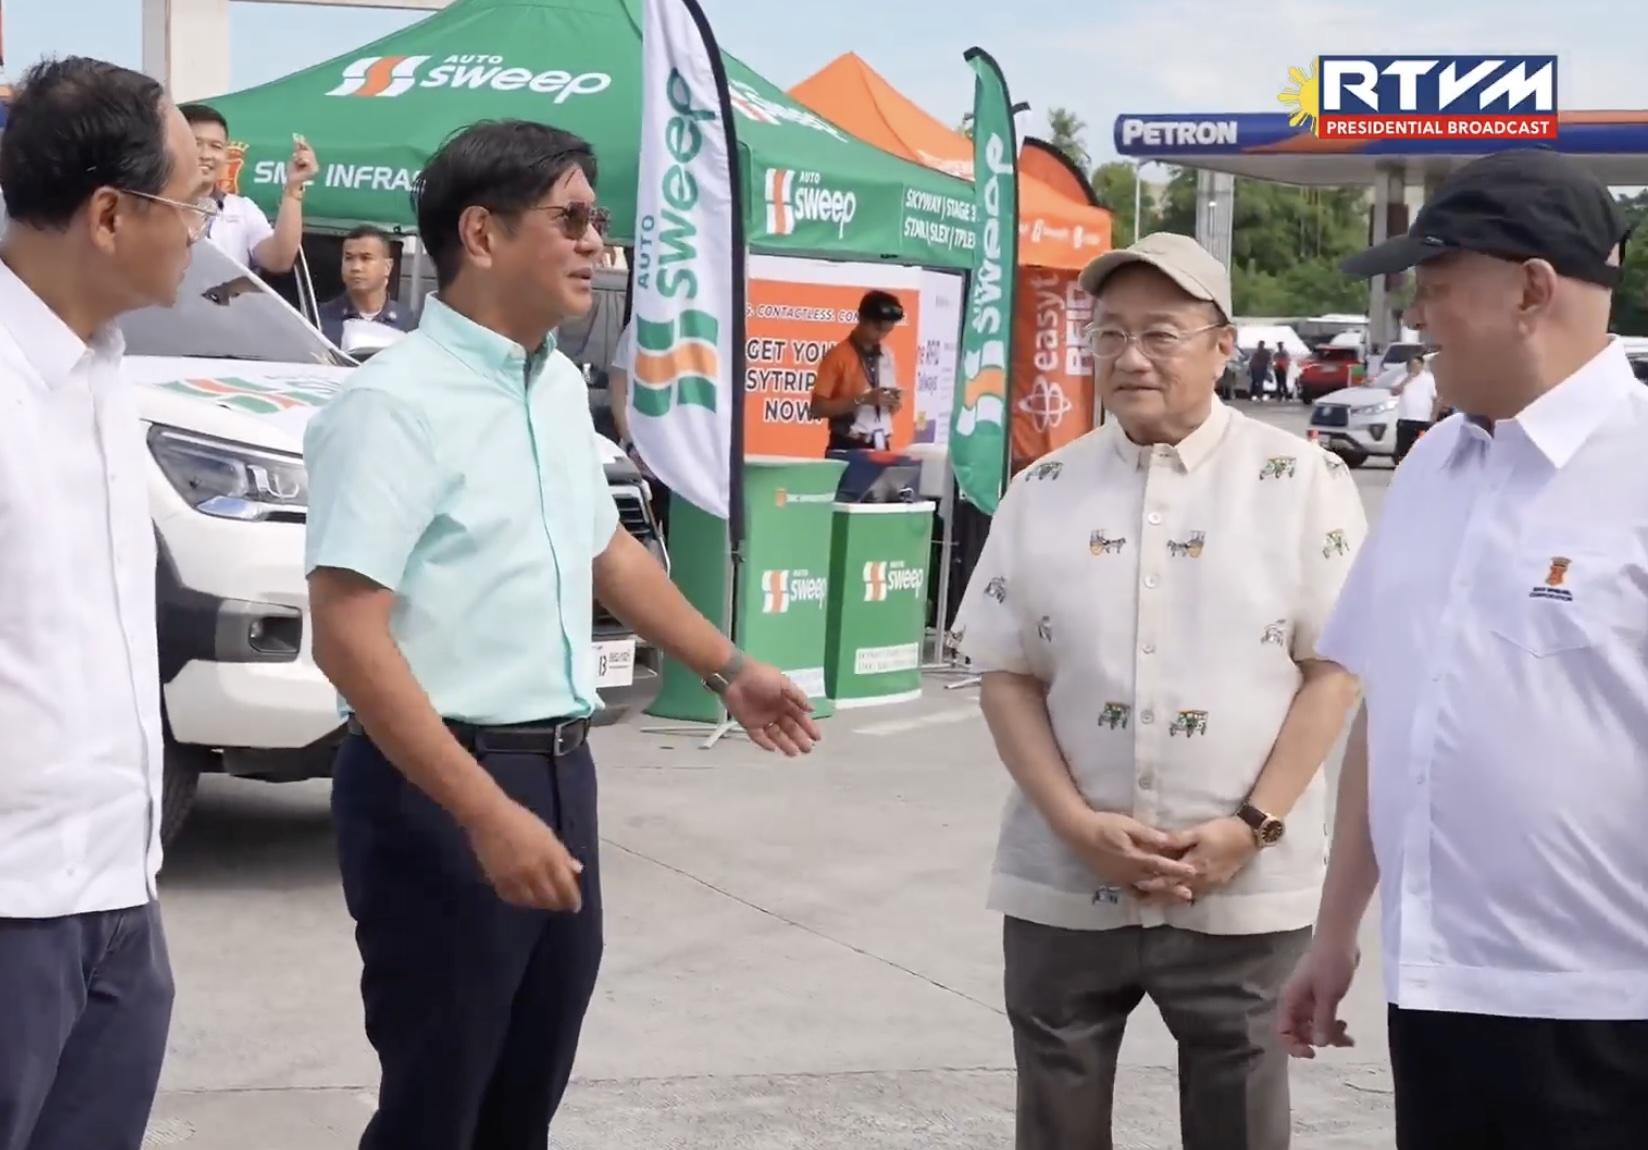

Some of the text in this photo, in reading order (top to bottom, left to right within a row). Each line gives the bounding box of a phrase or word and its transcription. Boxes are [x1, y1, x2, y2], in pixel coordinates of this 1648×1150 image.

[443, 54, 504, 65] AUTO
[419, 64, 612, 104] sweep
[1122, 119, 1238, 146] PETRON
[253, 161, 315, 187] SM
[656, 67, 716, 300] sweep
[799, 171, 821, 184] AUTO
[794, 187, 857, 240] sweep
[905, 188, 942, 214] SKYWAY
[946, 197, 970, 222] STAGE
[977, 132, 1014, 334] sweep
[638, 215, 655, 289] AUTO
[747, 339, 837, 363] GET YOU
[746, 369, 817, 391] SYTRIP
[790, 577, 828, 610] sweep
[887, 568, 924, 599] sweep
